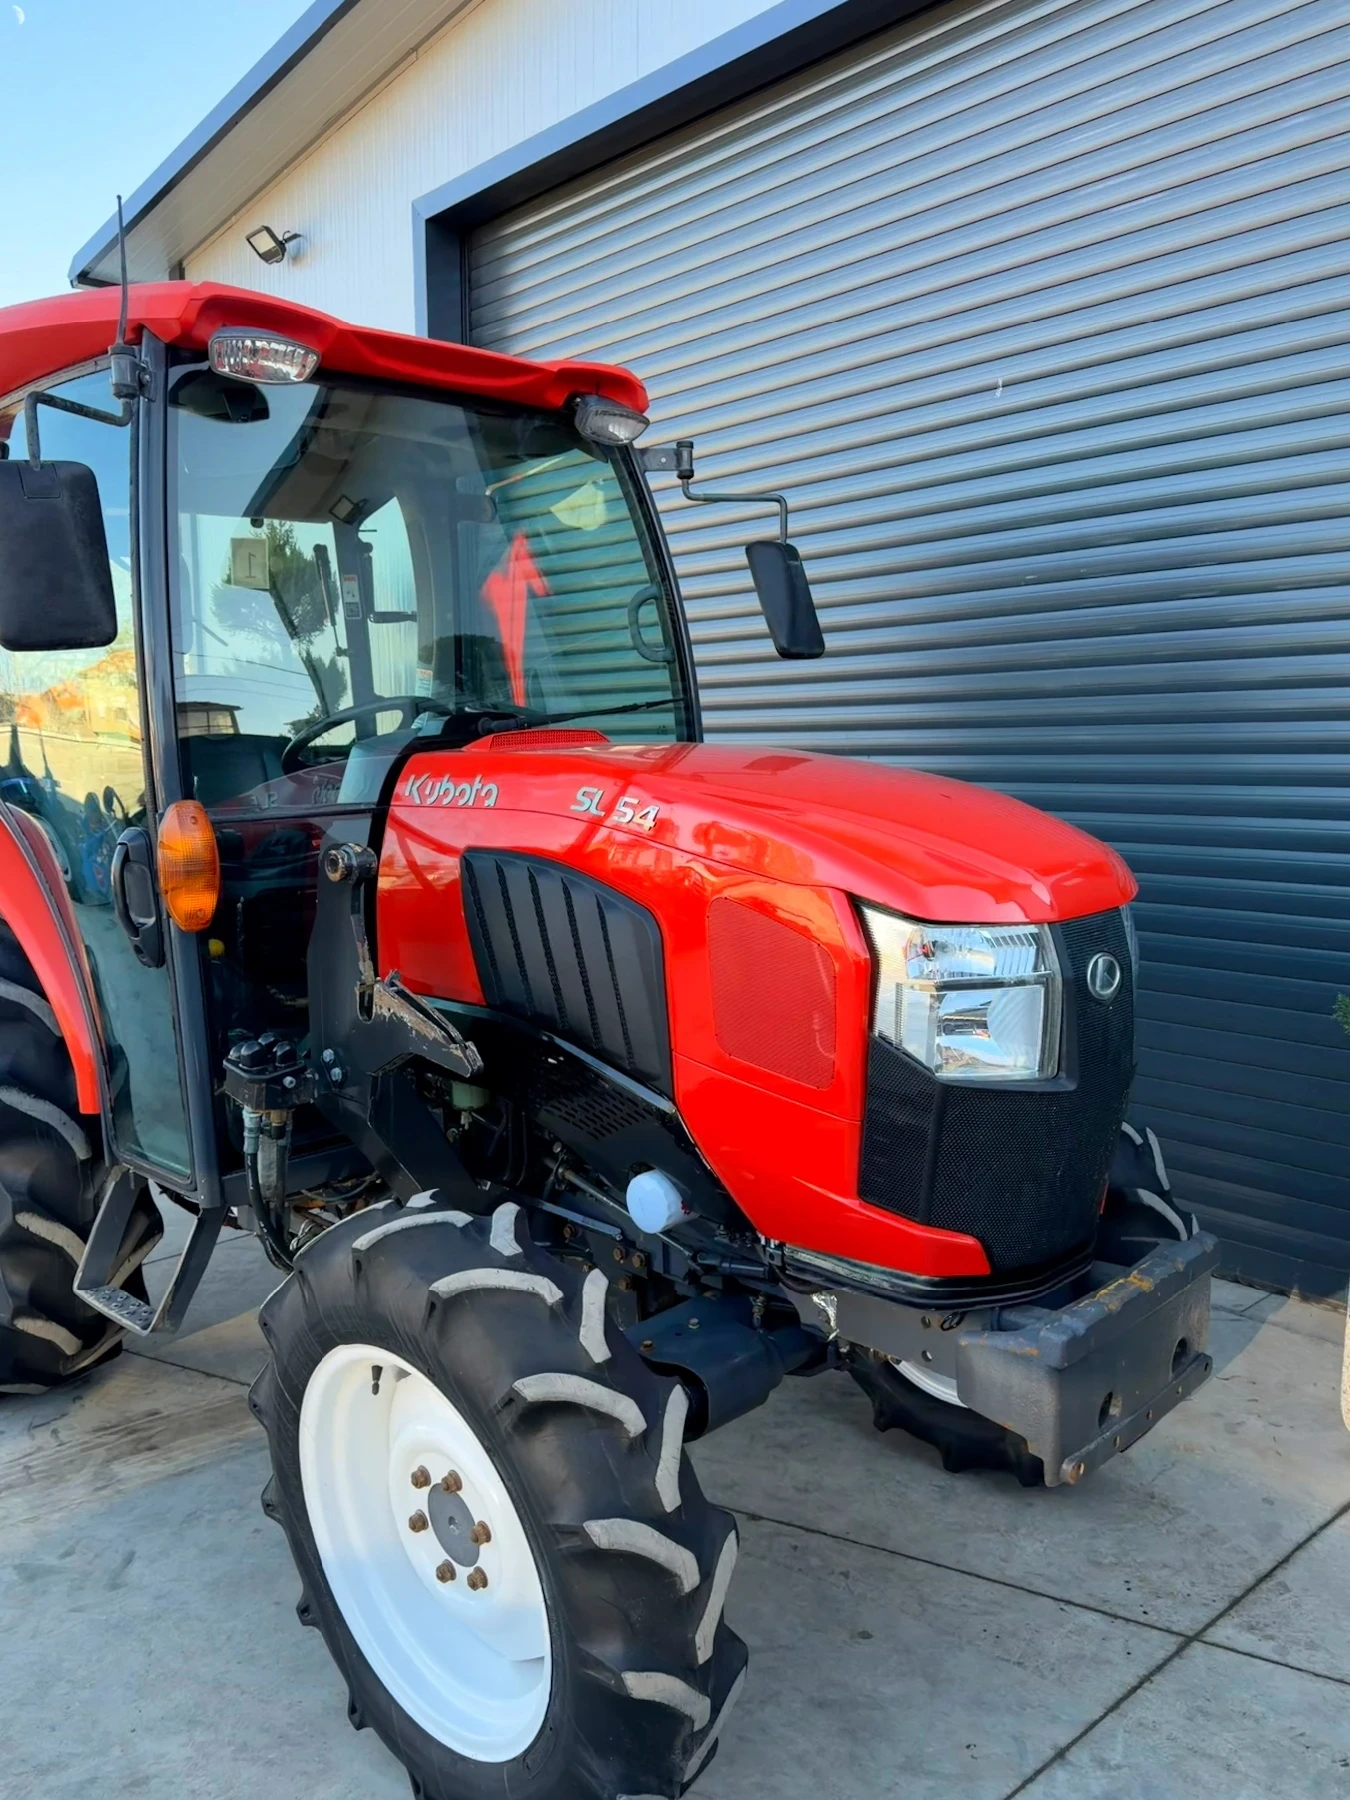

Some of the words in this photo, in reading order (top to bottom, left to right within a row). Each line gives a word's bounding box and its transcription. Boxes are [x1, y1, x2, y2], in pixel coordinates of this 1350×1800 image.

[404, 774, 500, 808] Kubota
[570, 785, 607, 817] SL
[613, 797, 661, 832] 54
